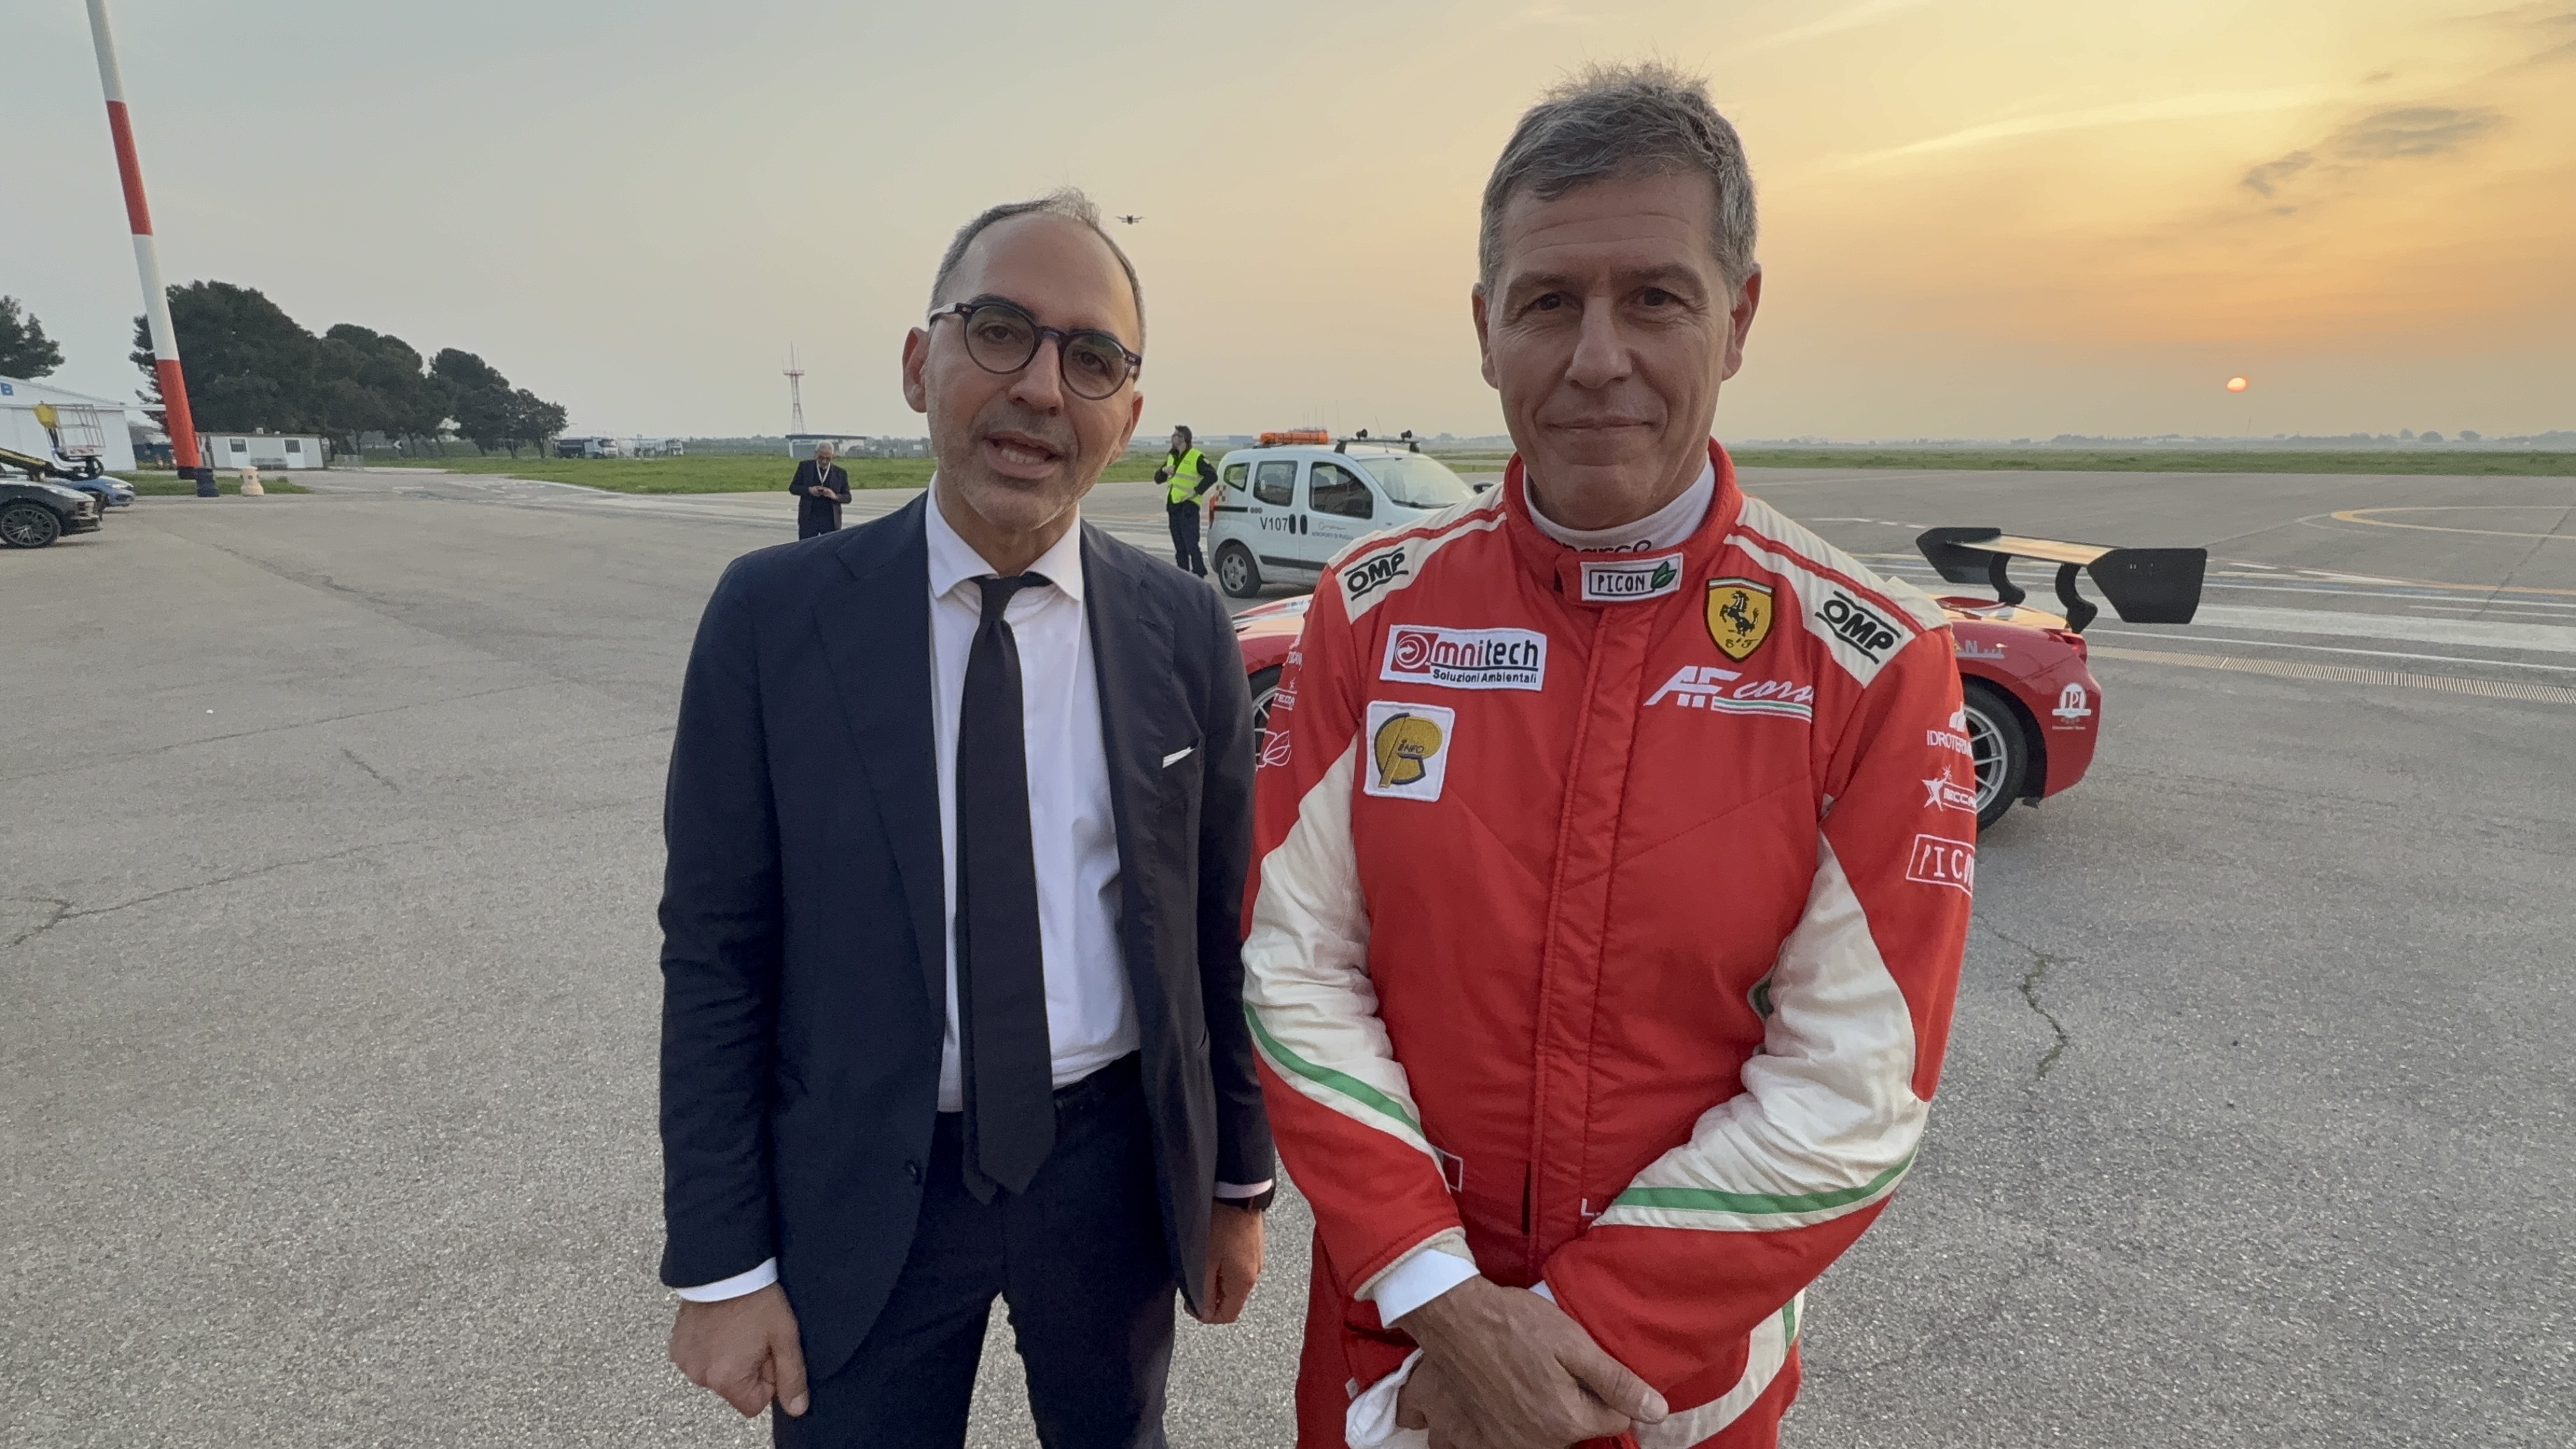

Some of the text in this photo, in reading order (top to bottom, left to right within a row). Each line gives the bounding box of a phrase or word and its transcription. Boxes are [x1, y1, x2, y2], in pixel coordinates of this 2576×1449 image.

[1260, 516, 1288, 531] V107
[1347, 551, 1406, 593] OMP
[1597, 574, 1645, 592] PICON
[1823, 599, 1895, 652] OMP
[1433, 668, 1536, 684] Soluzioni Ambientali
